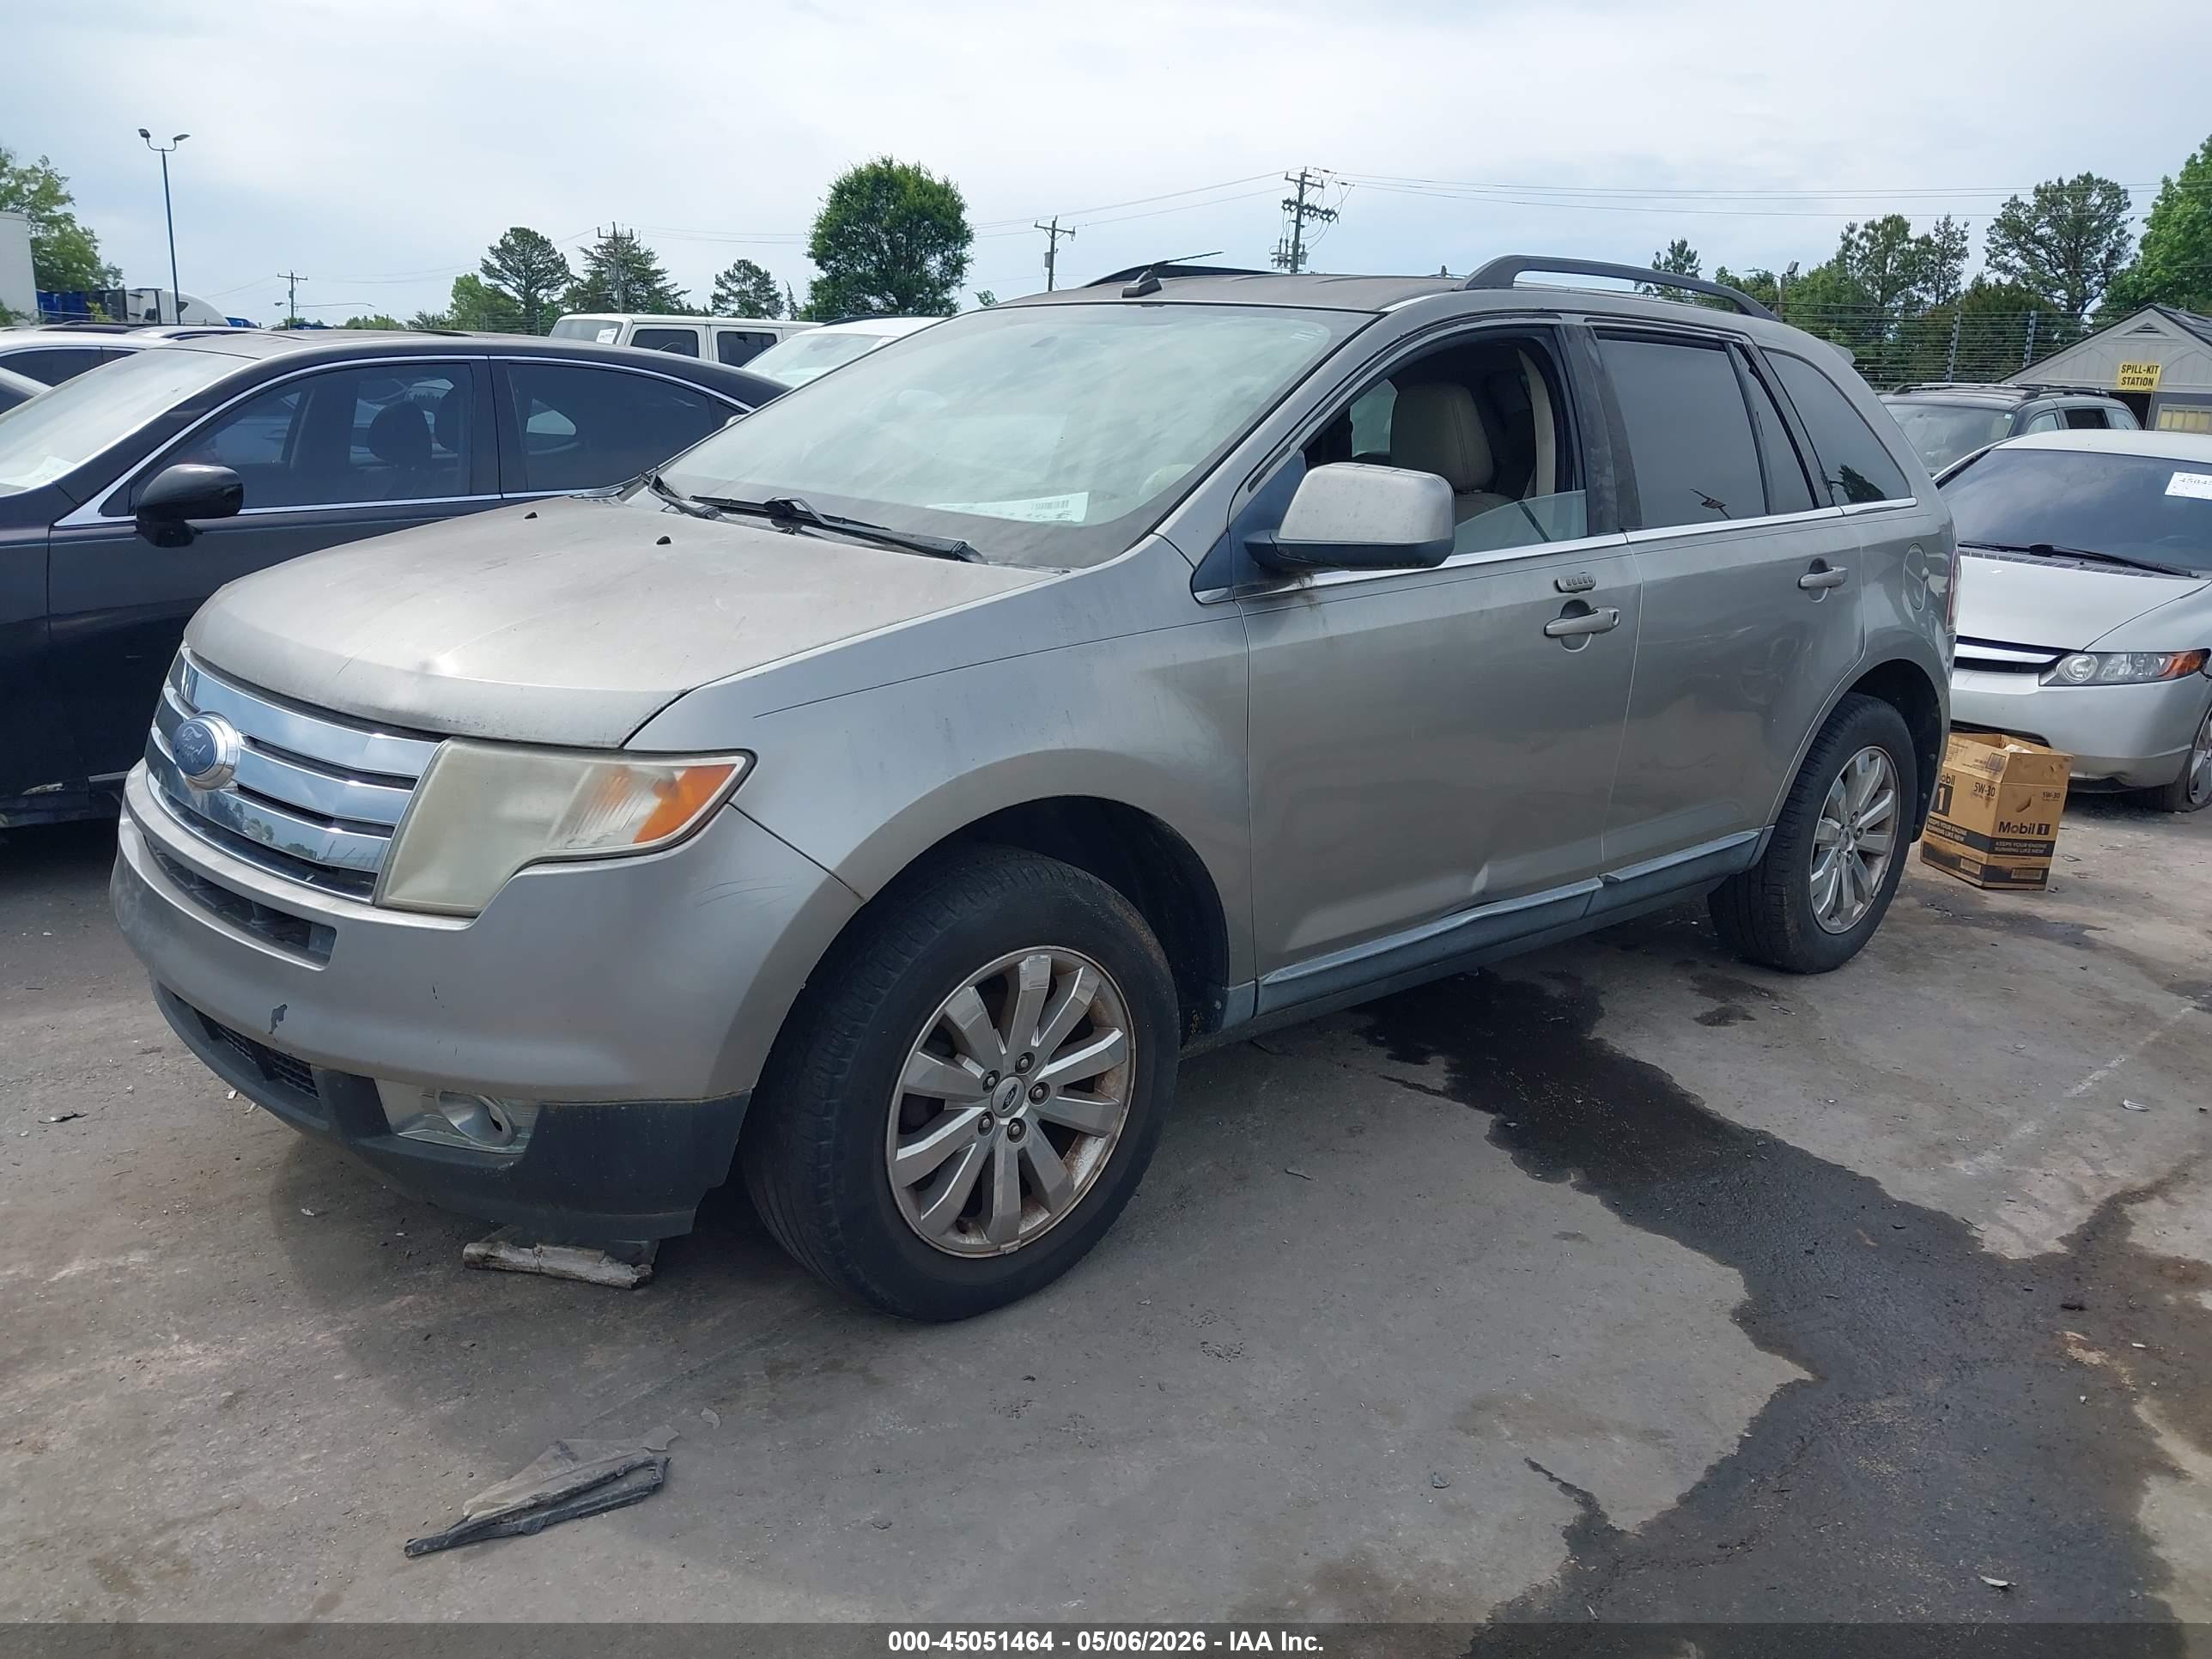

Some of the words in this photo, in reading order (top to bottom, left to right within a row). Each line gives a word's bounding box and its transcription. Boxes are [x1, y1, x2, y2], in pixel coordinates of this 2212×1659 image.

[2121, 364, 2160, 374] SPILL-KIT
[2121, 376, 2154, 386] STATION
[1940, 773, 1956, 785] obil
[1973, 782, 1996, 797] 5W-30
[1937, 787, 1946, 811] 1
[1998, 821, 2036, 835] Mobil
